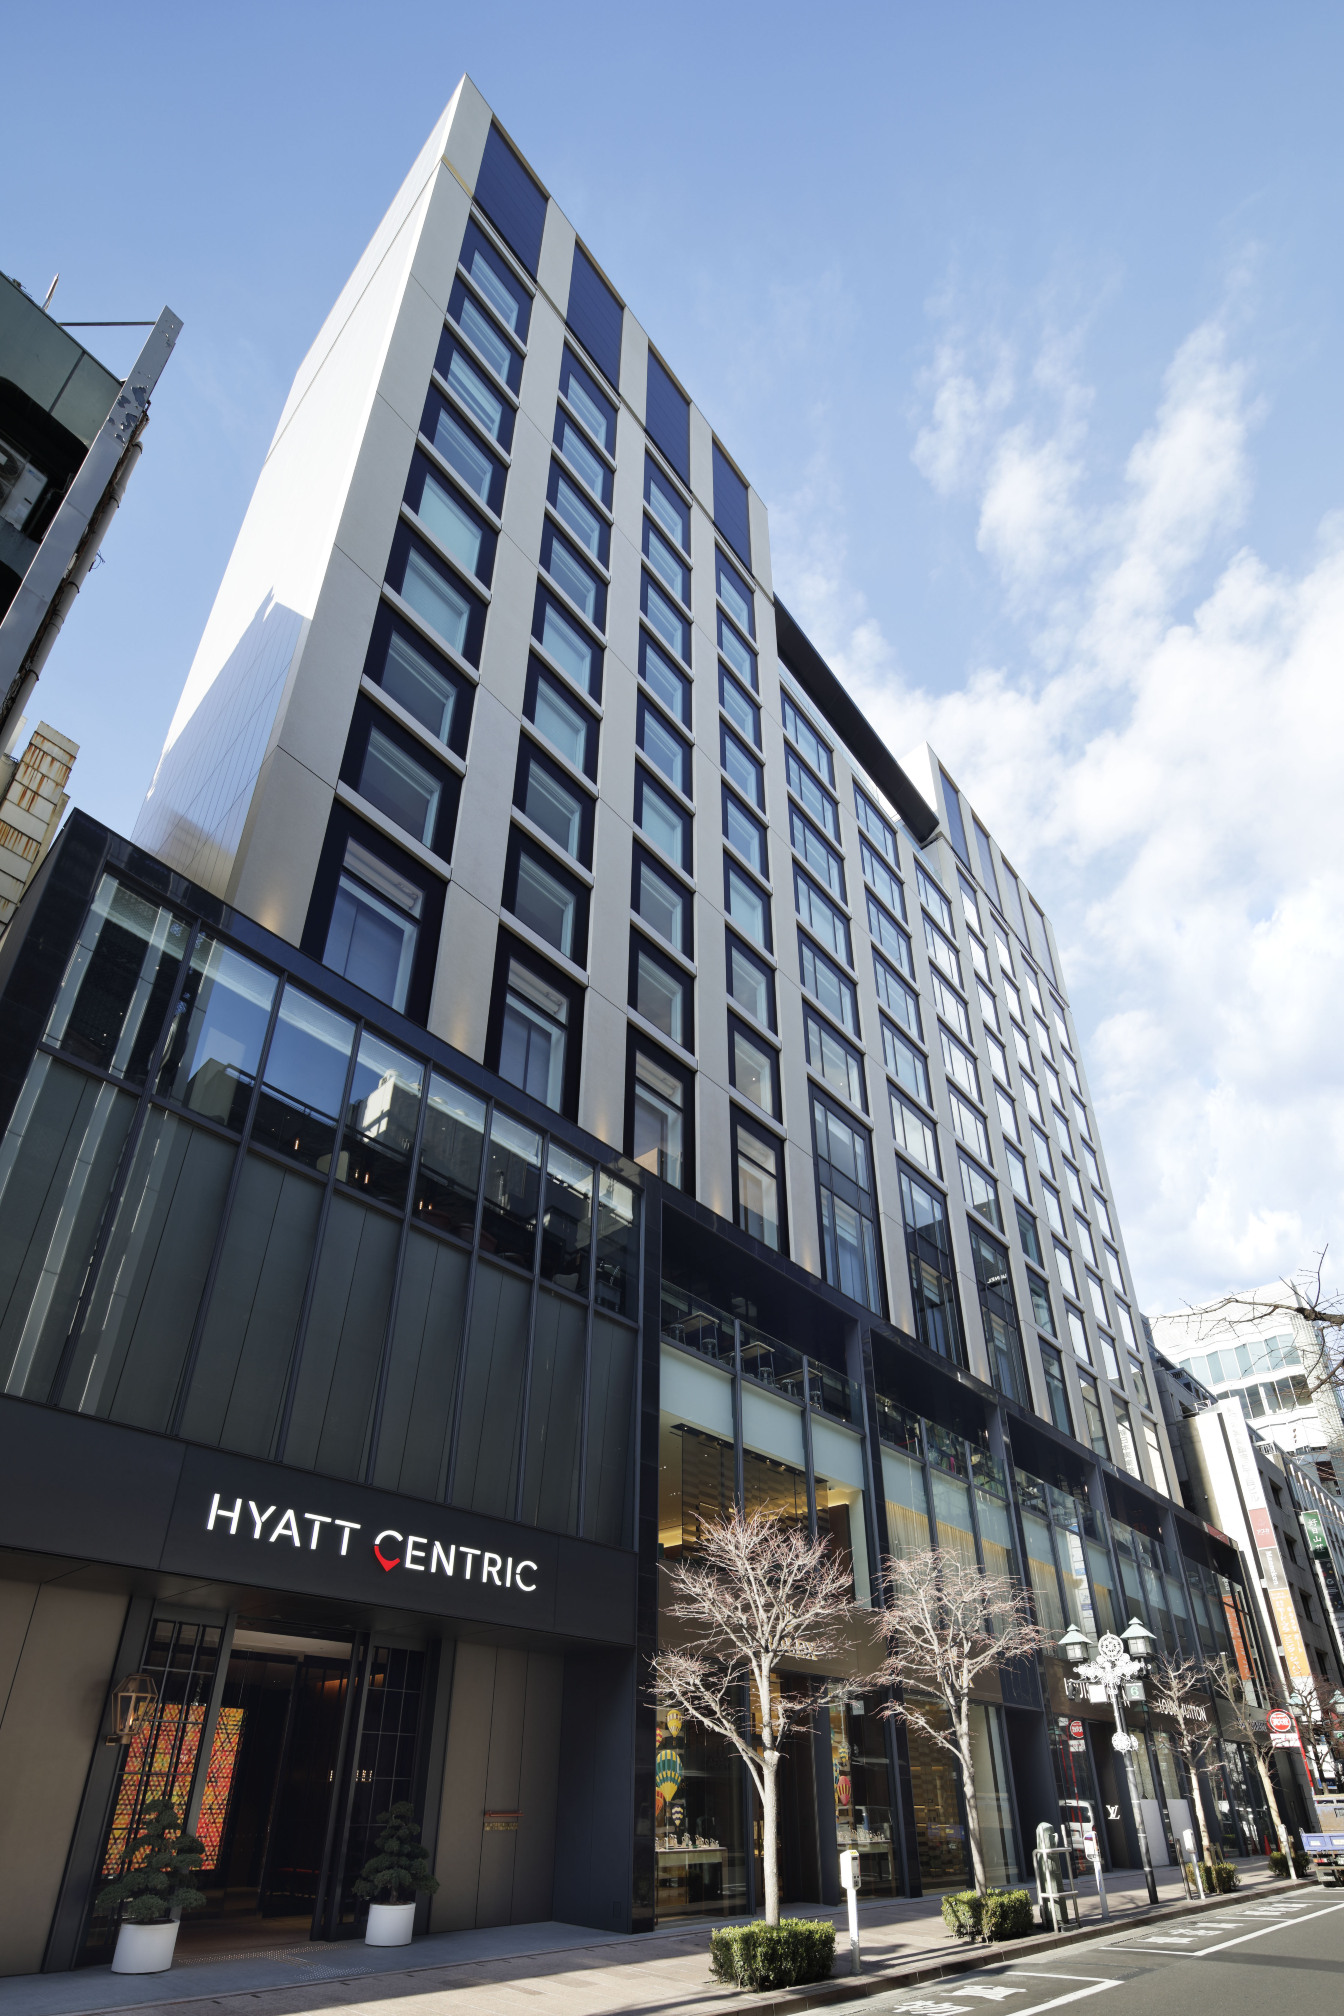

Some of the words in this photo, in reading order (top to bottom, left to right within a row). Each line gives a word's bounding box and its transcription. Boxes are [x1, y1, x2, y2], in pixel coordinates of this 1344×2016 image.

[207, 1493, 361, 1556] HYATT
[374, 1530, 538, 1592] CENTRIC
[1308, 1518, 1326, 1553] 好日山荘
[1130, 1686, 1139, 1696] 6
